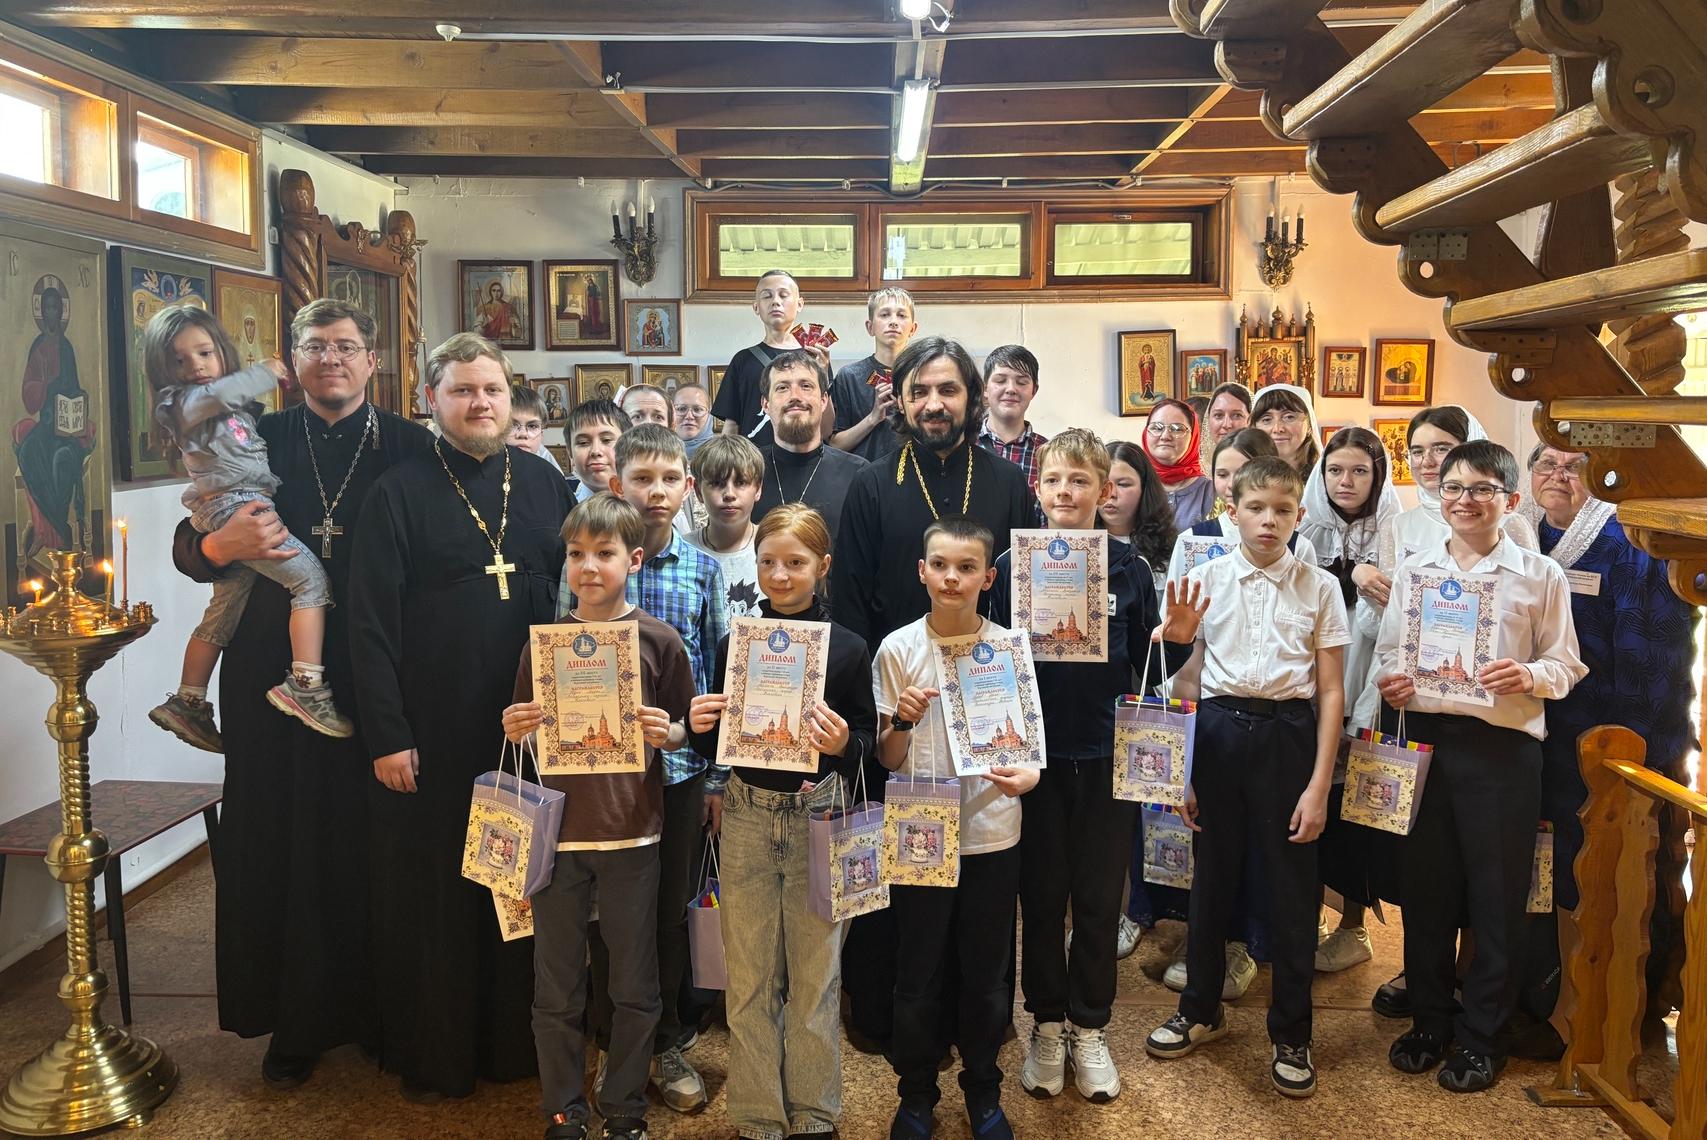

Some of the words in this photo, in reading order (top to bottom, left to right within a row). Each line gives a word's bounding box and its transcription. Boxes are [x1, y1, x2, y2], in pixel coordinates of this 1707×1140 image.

[1041, 562, 1078, 570] ДИПЛОМ
[1432, 600, 1469, 611] ДИПЛОМ
[566, 659, 607, 669] ДИПЛОМ
[759, 654, 797, 664] ДИПЛОМ
[968, 663, 1005, 676] ДИПЛОМ
